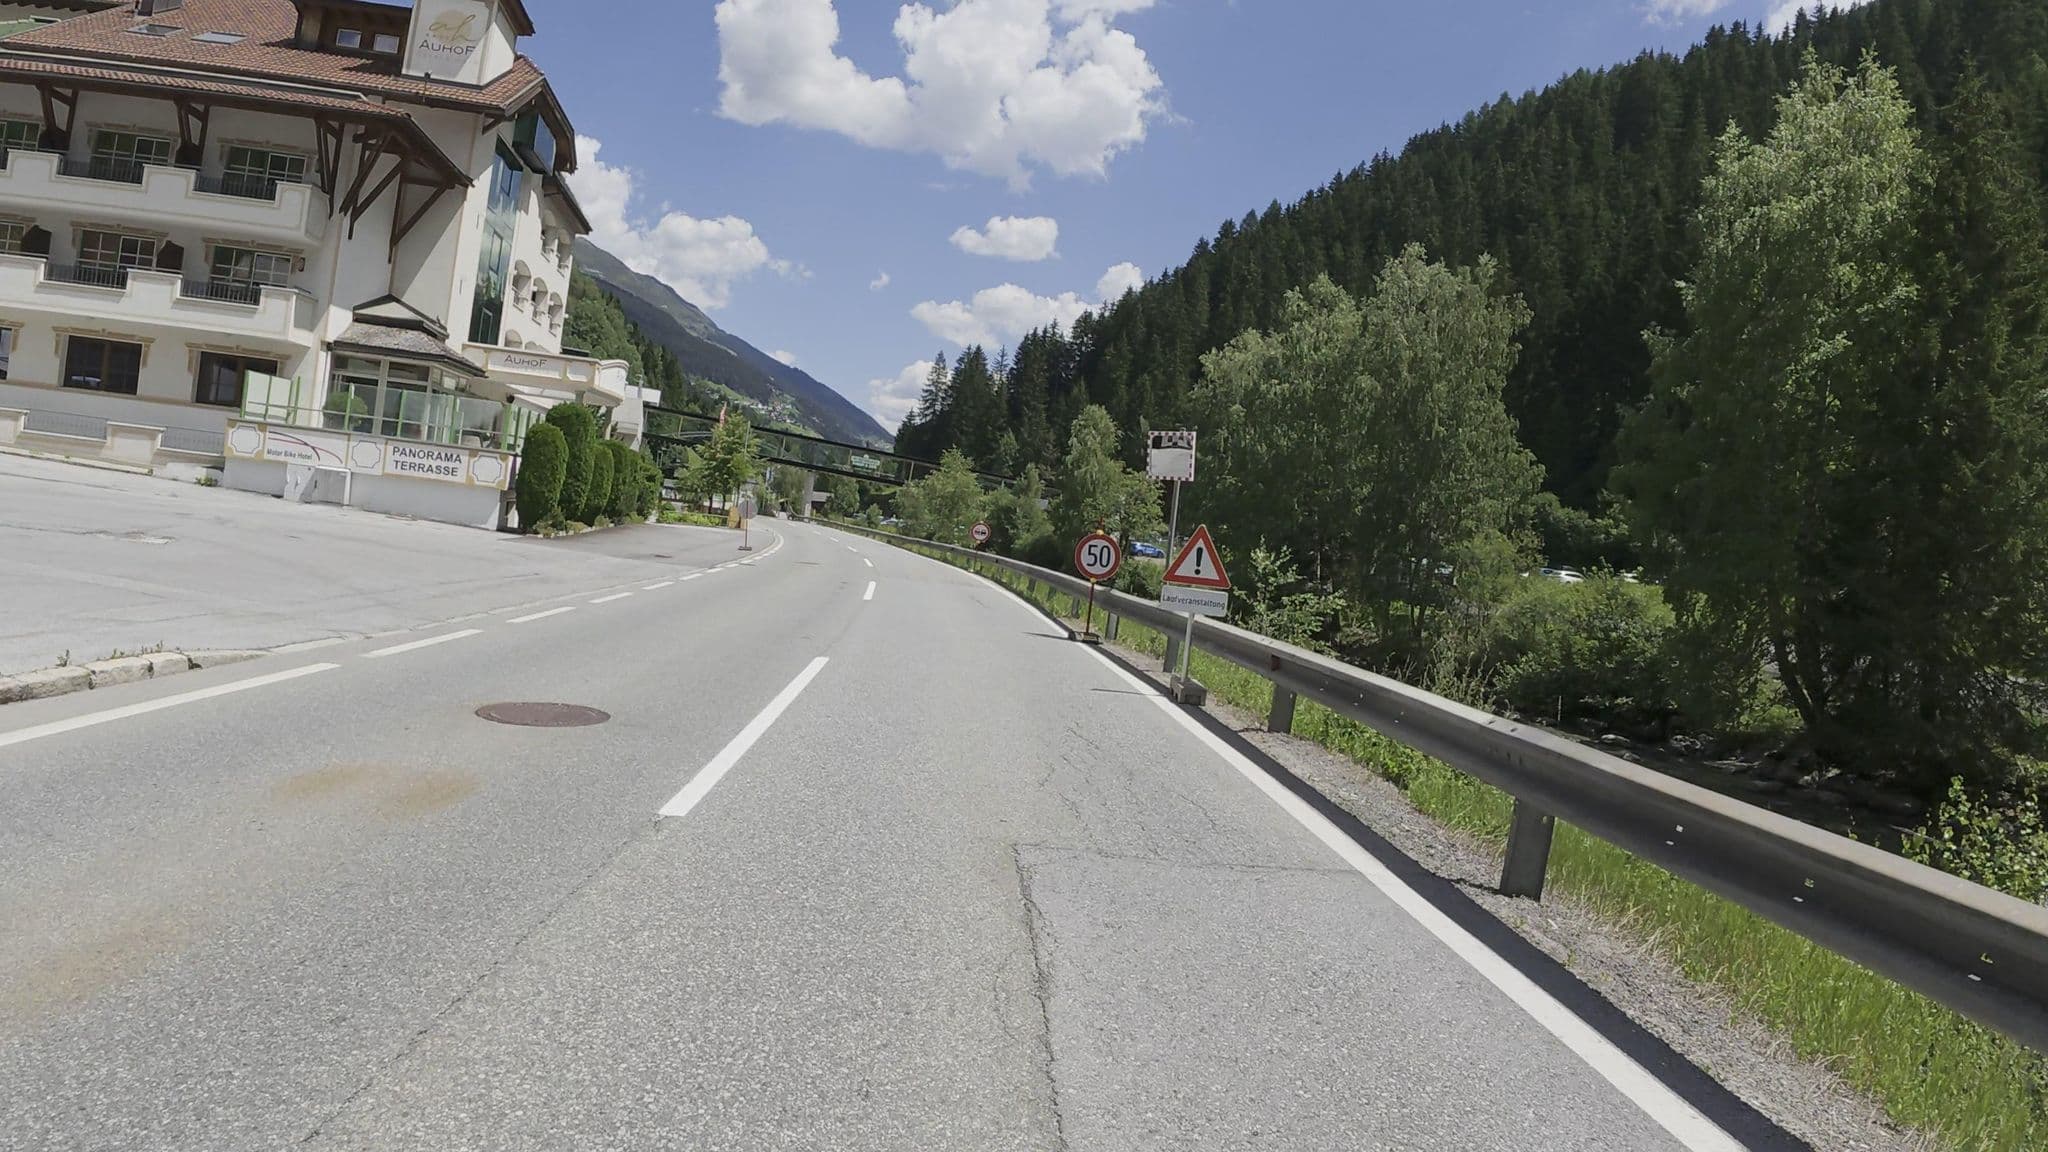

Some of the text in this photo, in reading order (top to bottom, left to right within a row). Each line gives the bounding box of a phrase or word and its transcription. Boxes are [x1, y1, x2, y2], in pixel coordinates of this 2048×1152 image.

[297, 452, 313, 460] Hotel
[392, 446, 462, 464] PANORAMA
[393, 460, 459, 476] TERRASSE
[1086, 544, 1111, 568] 50
[1162, 595, 1226, 610] Laufveranstaltung
